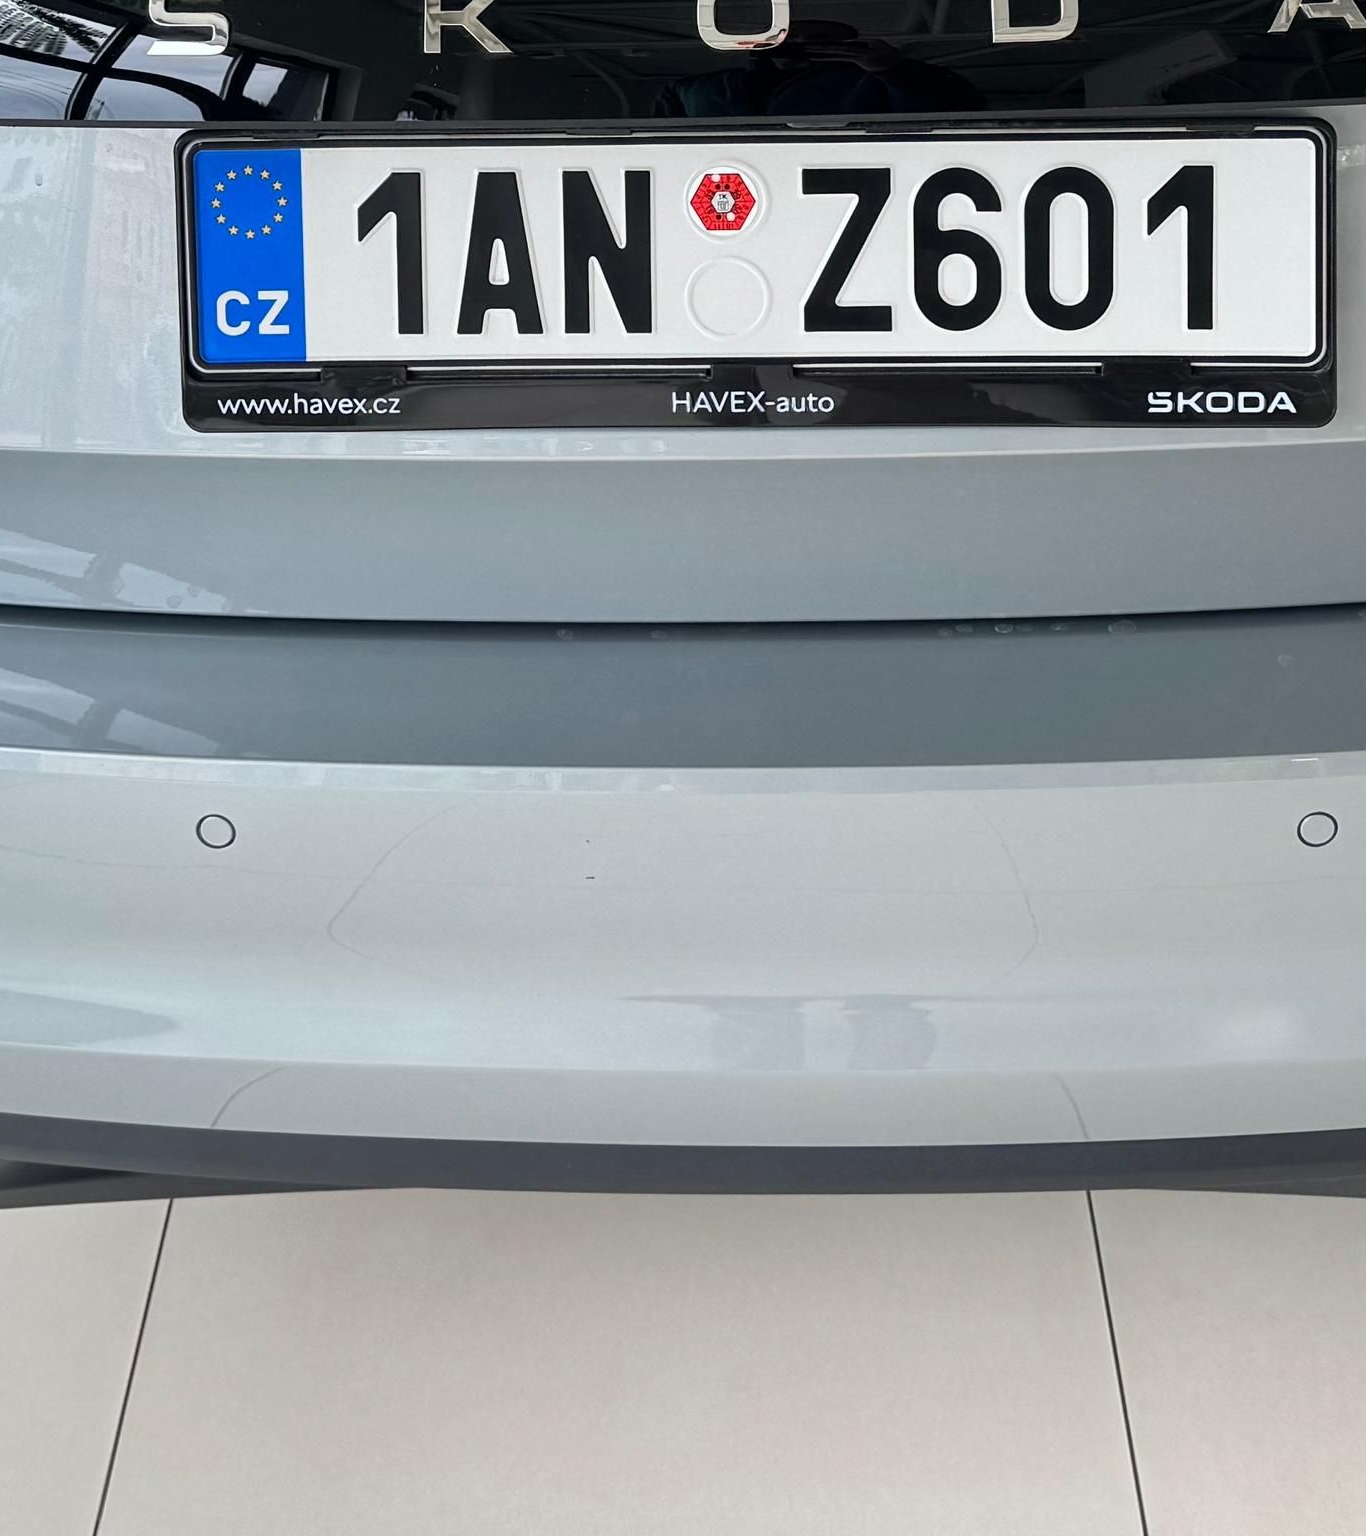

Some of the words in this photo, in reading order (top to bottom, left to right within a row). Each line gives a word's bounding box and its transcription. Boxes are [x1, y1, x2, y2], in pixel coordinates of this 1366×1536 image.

[356, 169, 654, 335] 1AN
[800, 164, 1215, 332] Z601
[216, 290, 290, 336] CZ
[217, 392, 401, 415] www.havex.cz
[671, 390, 835, 414] HAVEX-auto
